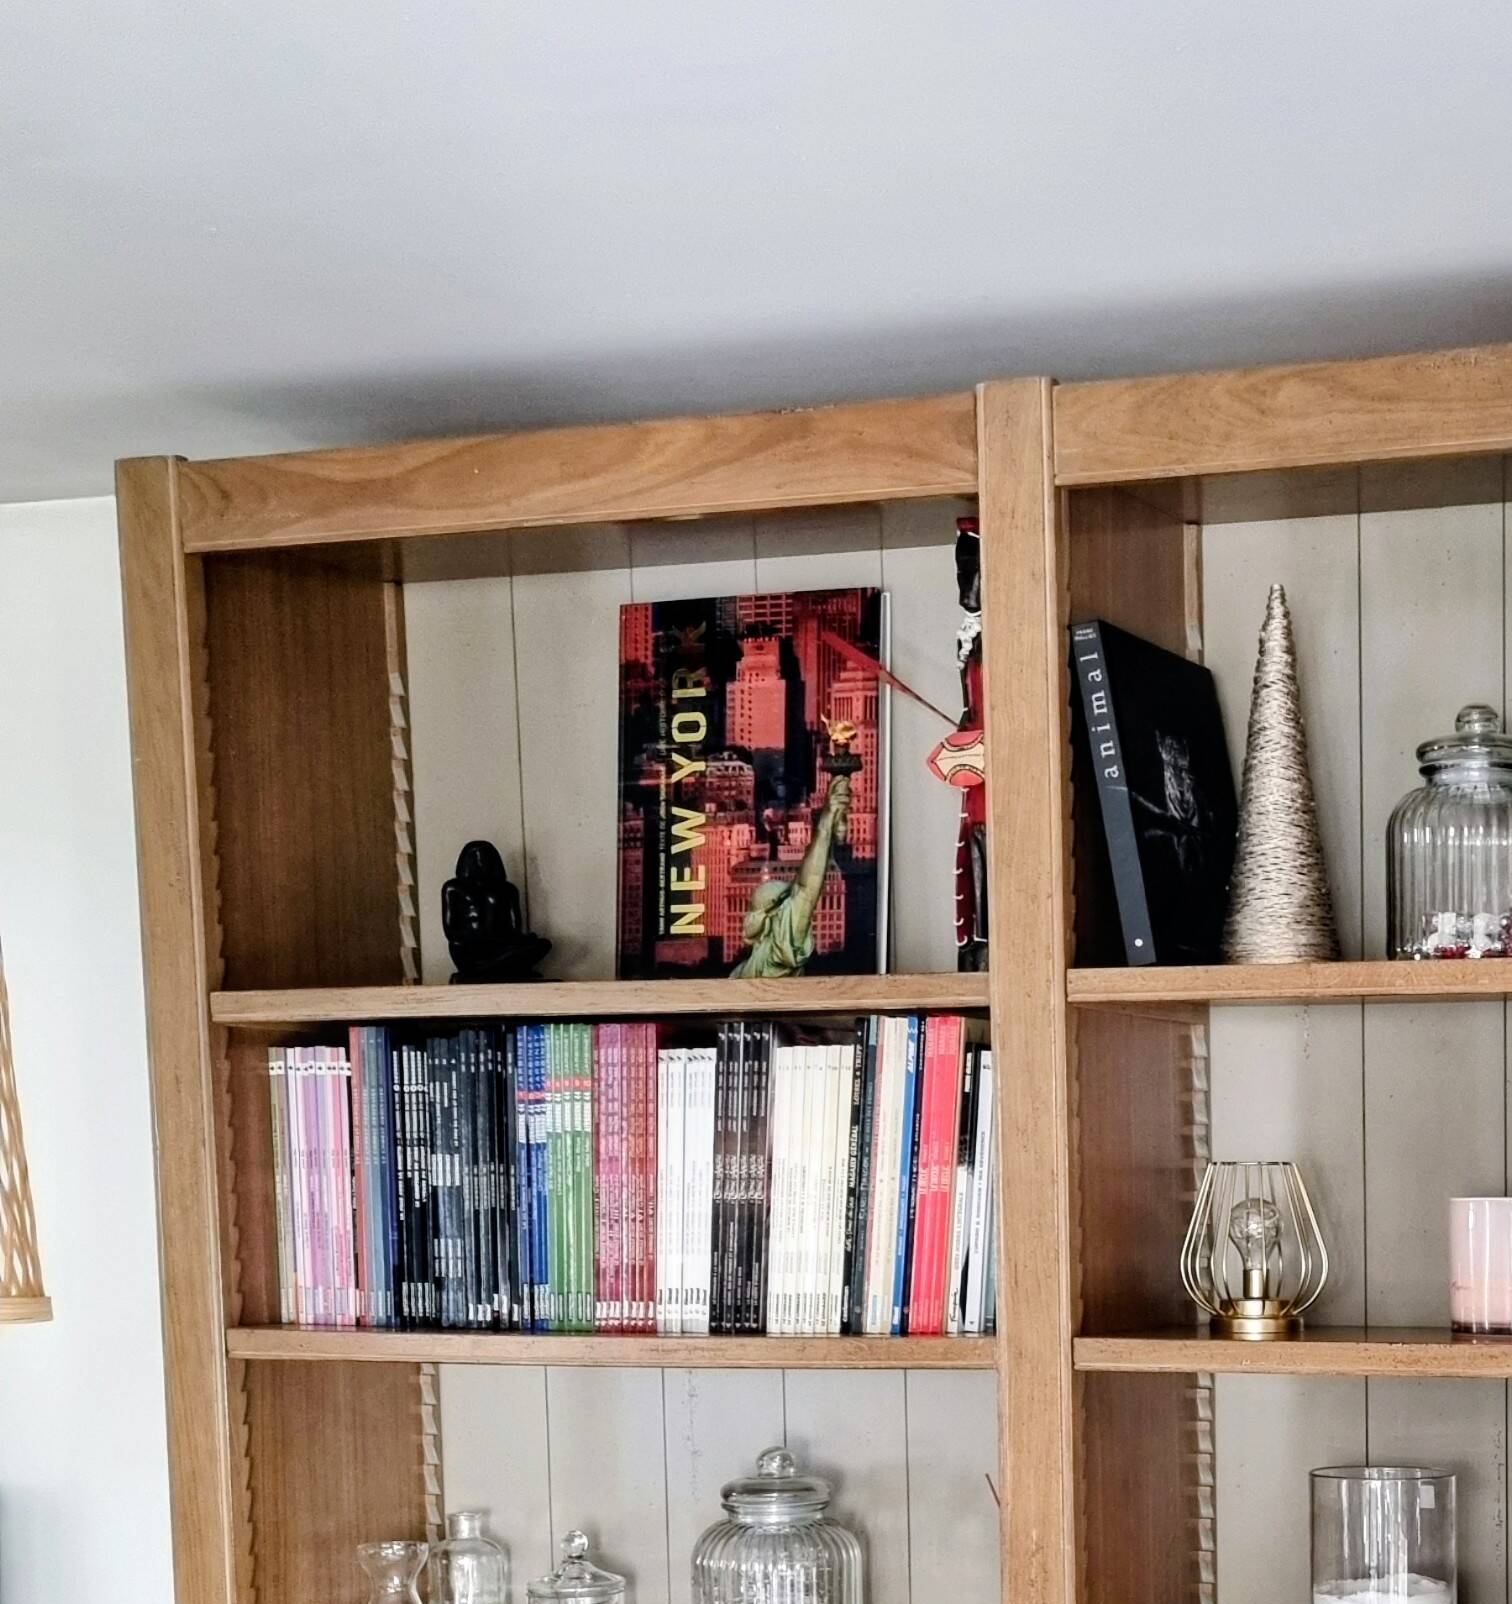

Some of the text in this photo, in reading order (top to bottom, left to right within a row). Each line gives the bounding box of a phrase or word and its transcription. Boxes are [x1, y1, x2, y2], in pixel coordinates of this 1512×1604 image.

[670, 620, 707, 934] NEW YORK
[1080, 652, 1120, 779] animal
